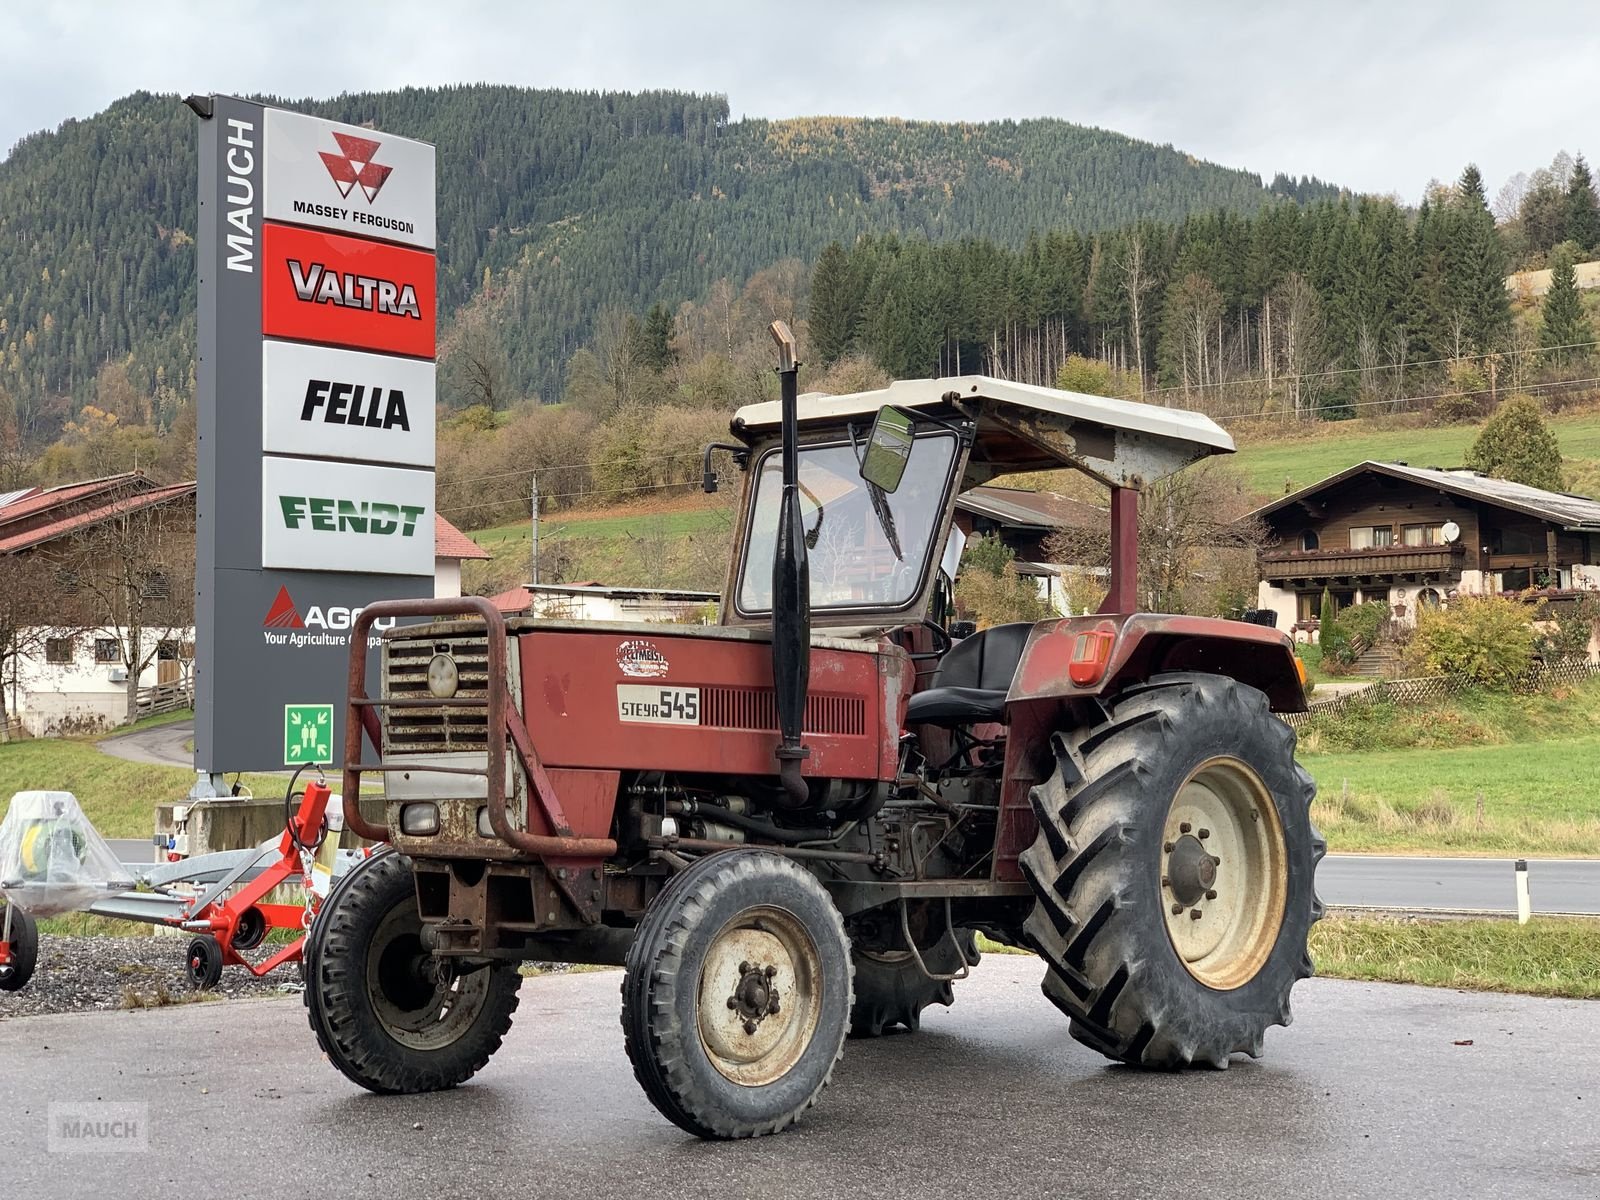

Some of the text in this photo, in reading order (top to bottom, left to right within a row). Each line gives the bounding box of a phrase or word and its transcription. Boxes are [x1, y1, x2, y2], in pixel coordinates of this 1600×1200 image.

[226, 118, 254, 273] MAUCH
[293, 200, 414, 234] MASSEY FERGUSON
[286, 258, 421, 320] VALTRA
[300, 379, 410, 432] FELLA
[279, 495, 425, 537] FENDT
[264, 631, 287, 645] Your
[289, 632, 345, 648] Agriculture
[621, 691, 697, 720] STEYR 545
